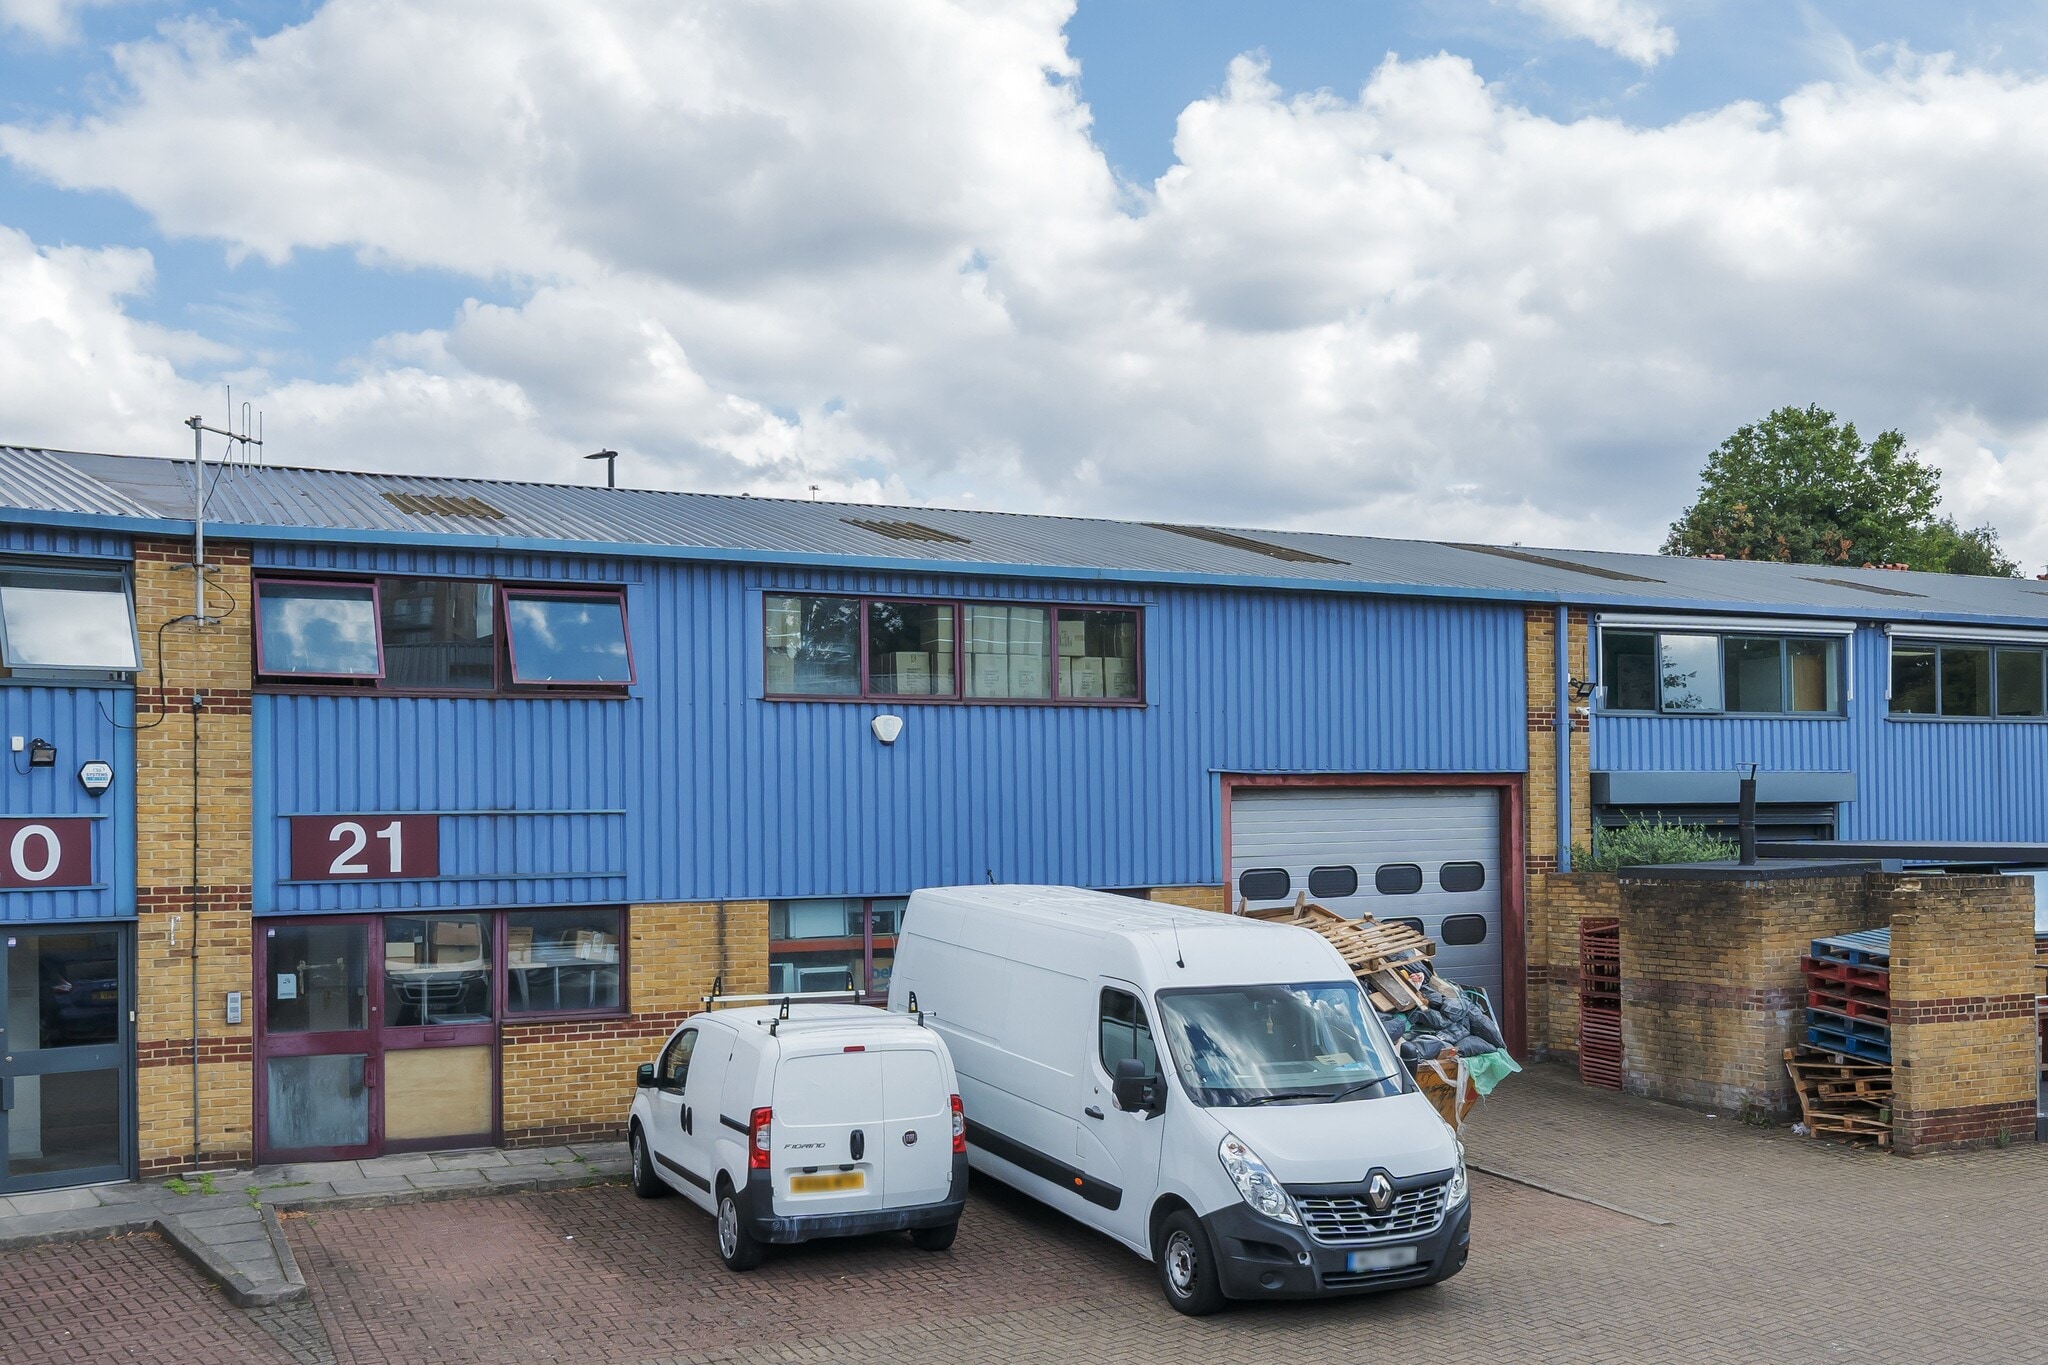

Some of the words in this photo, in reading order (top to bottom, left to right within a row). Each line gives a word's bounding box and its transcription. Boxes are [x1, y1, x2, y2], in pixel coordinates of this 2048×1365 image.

[0, 824, 61, 881] 0
[329, 821, 402, 874] 21
[905, 1133, 915, 1143] FIAT
